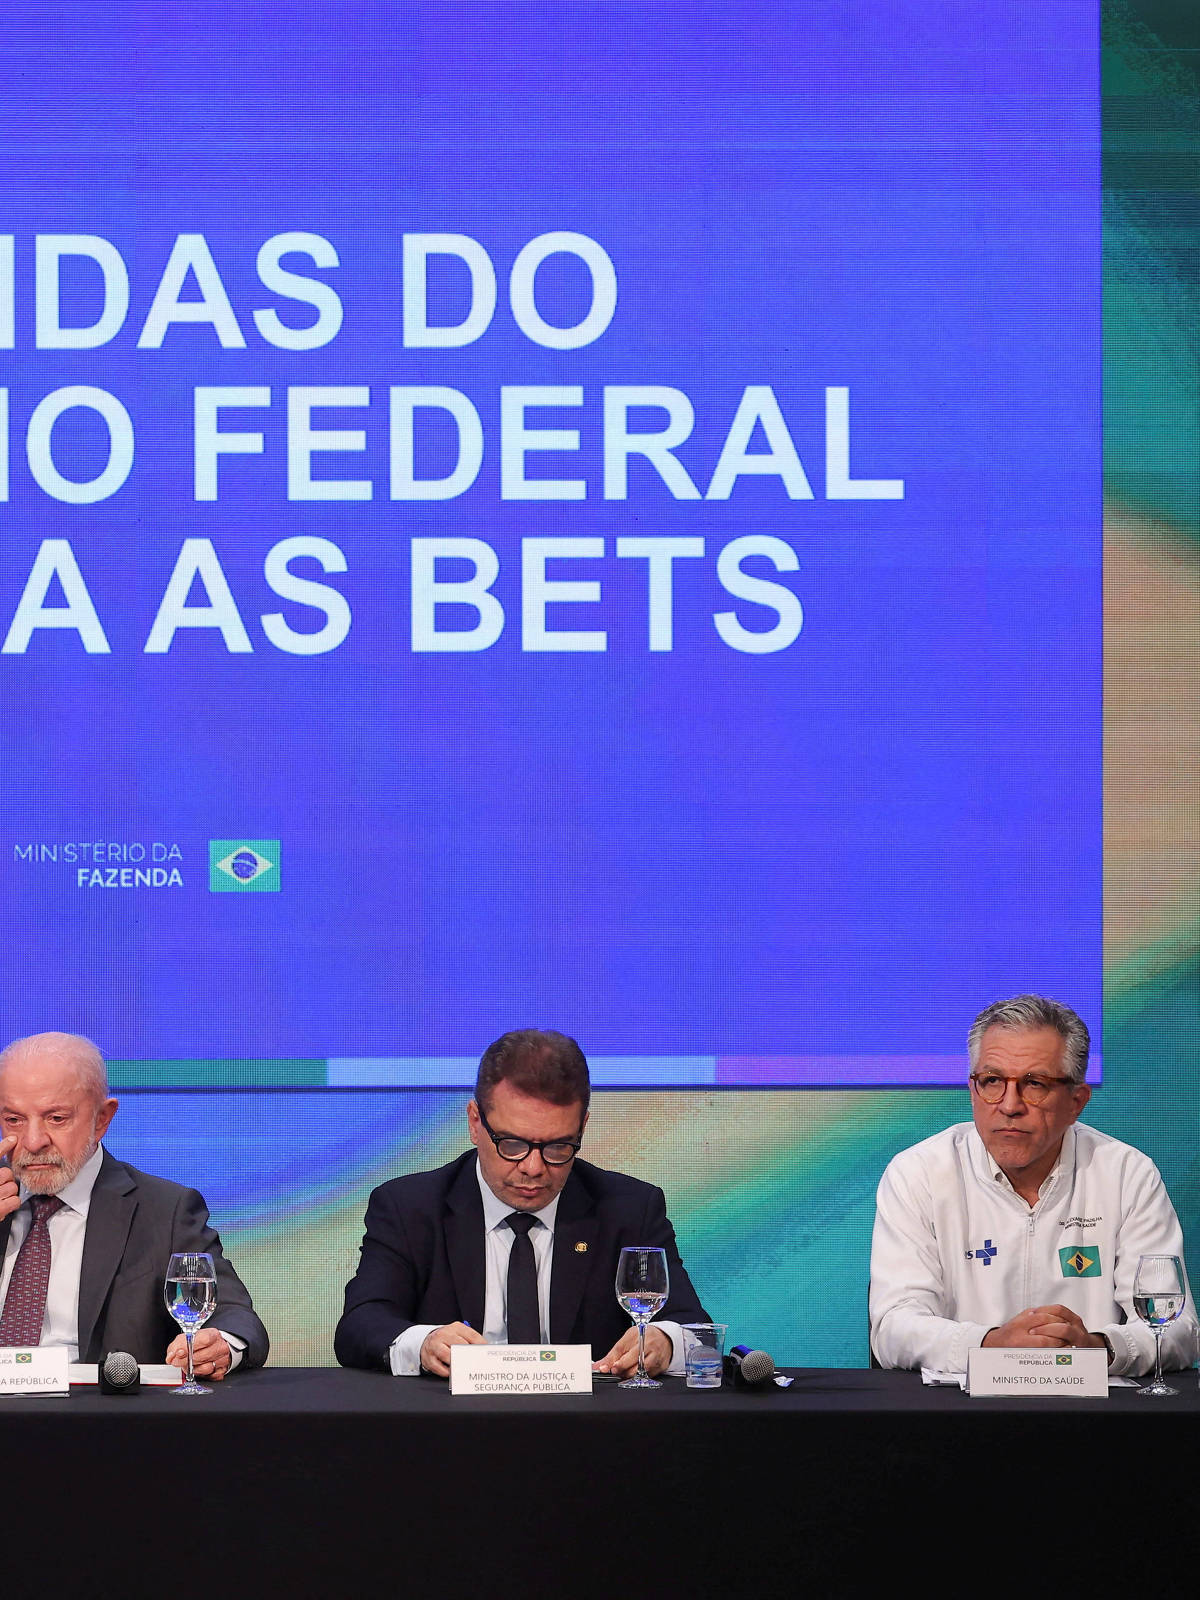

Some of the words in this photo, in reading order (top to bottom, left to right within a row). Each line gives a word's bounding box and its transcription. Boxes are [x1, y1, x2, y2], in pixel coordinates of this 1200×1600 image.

[402, 231, 617, 350] DO
[194, 385, 904, 502] FEDERAL
[143, 537, 353, 655] AS
[411, 535, 803, 653] BETS
[13, 839, 146, 863] MINISTÉRIO
[151, 843, 183, 861] DA
[77, 867, 184, 888] FAZENDA
[9, 1376, 59, 1385] REPÚBLICA
[469, 1372, 514, 1381] MINISTRO
[516, 1372, 530, 1381] DA
[532, 1372, 568, 1382] JUSTIÇA
[570, 1372, 575, 1380] E
[474, 1383, 531, 1392] SEGURANÇA
[992, 1376, 1037, 1384] MINISTRO
[1039, 1377, 1052, 1385] DA
[1054, 1375, 1085, 1385] SAÚDE
